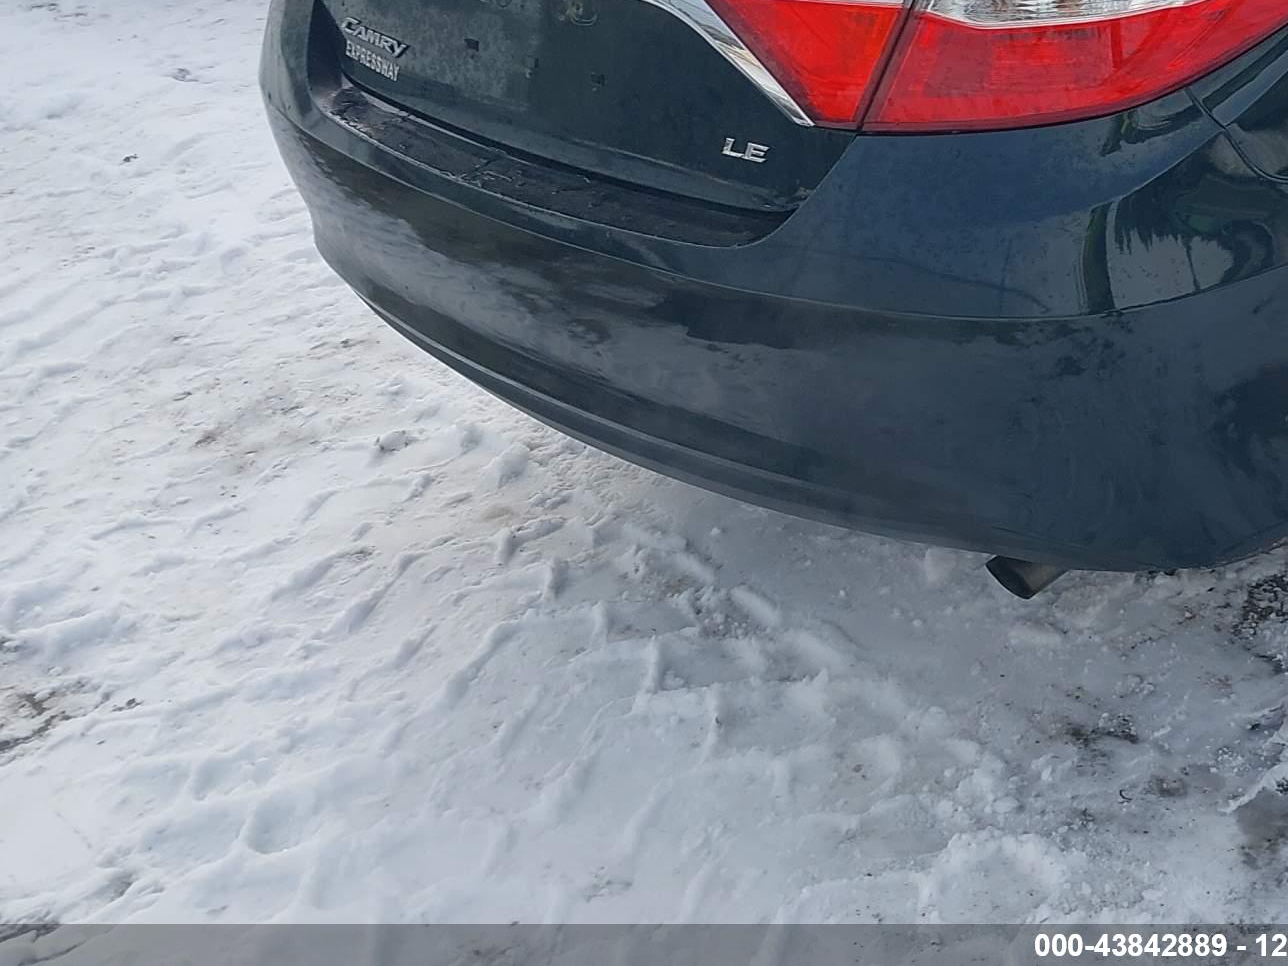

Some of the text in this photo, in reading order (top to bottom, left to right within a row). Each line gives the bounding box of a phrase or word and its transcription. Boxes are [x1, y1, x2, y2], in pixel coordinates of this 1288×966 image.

[341, 17, 408, 58] CAMRY
[345, 39, 400, 82] EXPRESSWAY
[722, 137, 770, 163] LE
